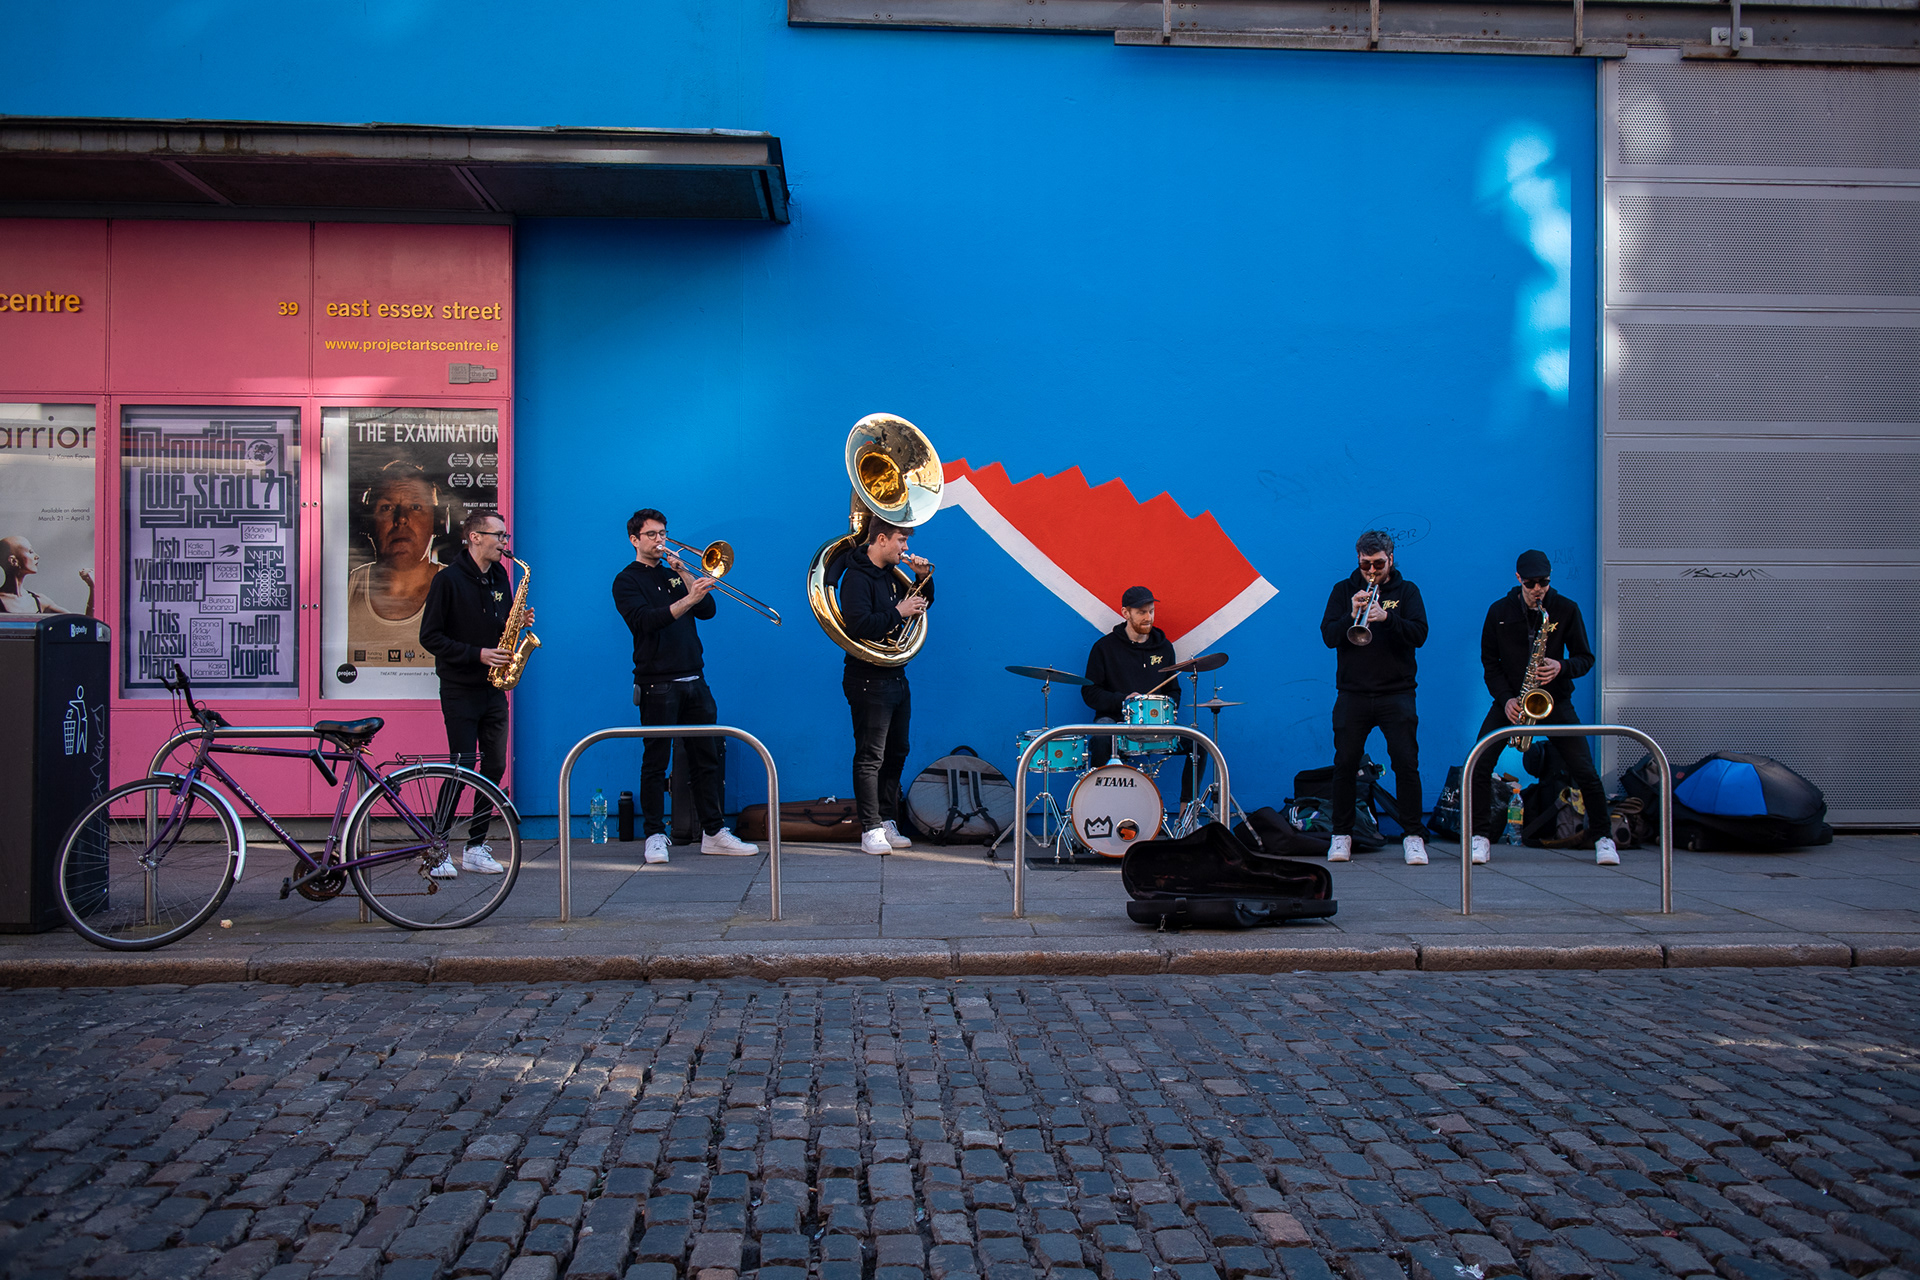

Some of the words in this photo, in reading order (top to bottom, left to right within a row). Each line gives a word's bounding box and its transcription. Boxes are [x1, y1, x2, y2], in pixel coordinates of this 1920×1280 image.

[0, 290, 80, 313] centre
[278, 301, 299, 316] 39
[326, 299, 370, 317] east
[377, 302, 434, 319] essex
[442, 301, 502, 320] street
[325, 338, 499, 353] www.projectartscentre.ie
[355, 423, 387, 442] THE
[394, 423, 498, 443] EXAMINATION
[247, 550, 282, 560] WHEN
[134, 559, 210, 581] Wildflower
[140, 581, 200, 603] Alphabet
[139, 631, 187, 657] Mossy
[229, 622, 255, 645] The
[231, 645, 280, 679] Project
[337, 669, 356, 677] project
[1102, 776, 1135, 788] TAMA
[236, 786, 292, 841] RALEIGH
